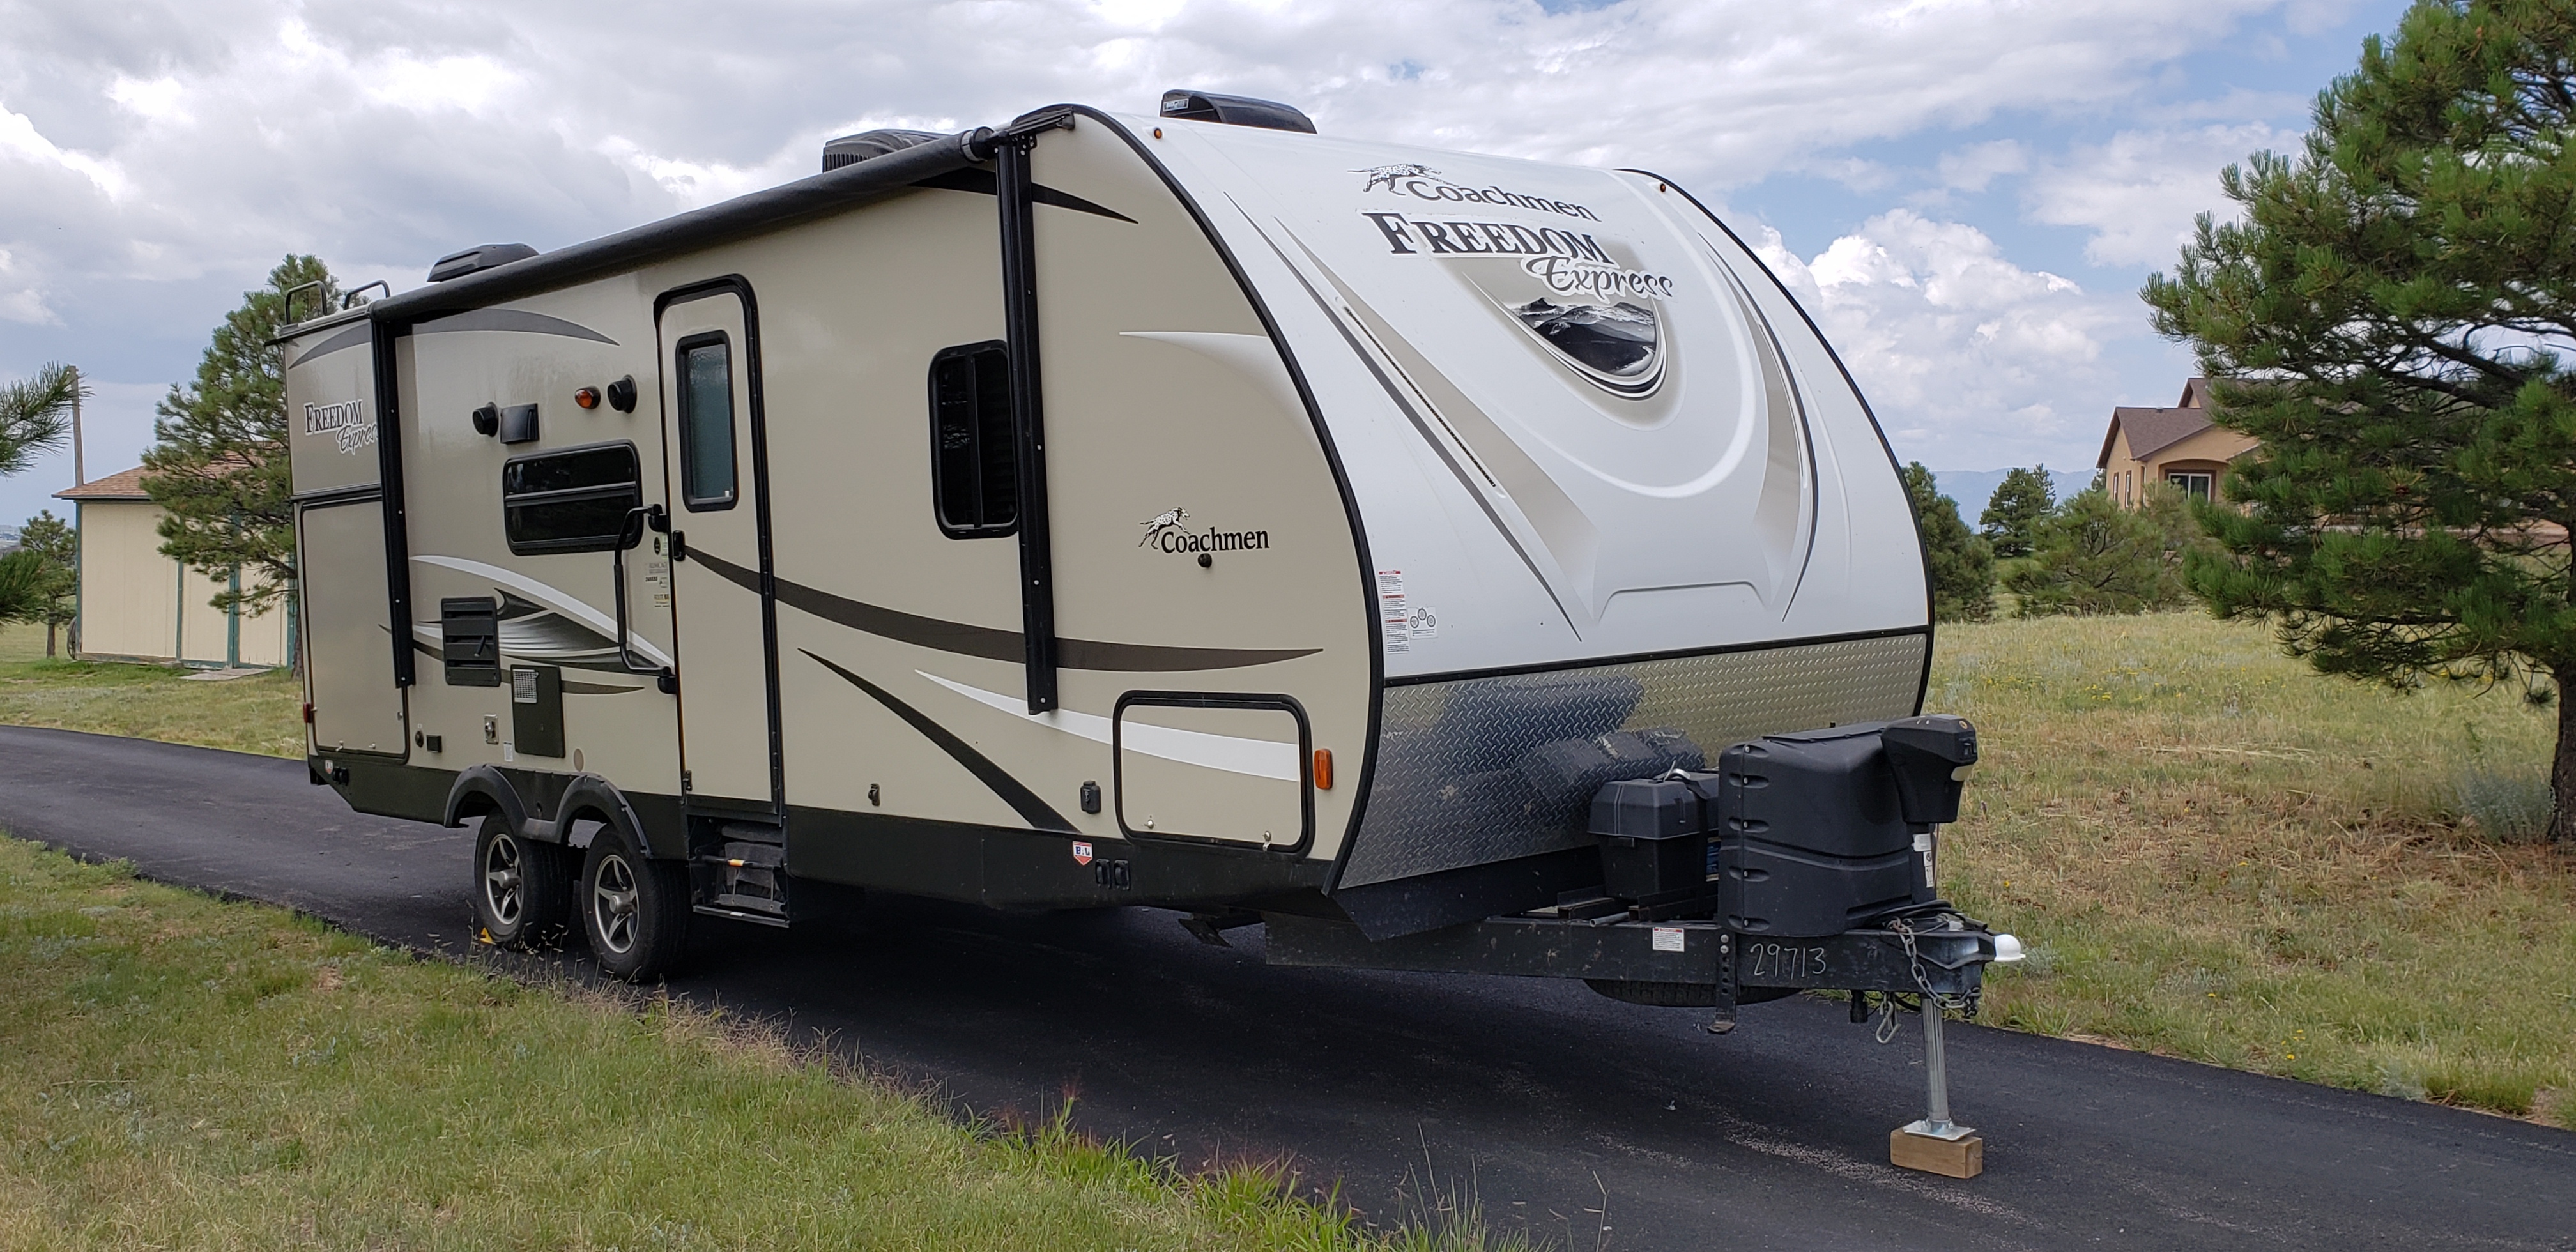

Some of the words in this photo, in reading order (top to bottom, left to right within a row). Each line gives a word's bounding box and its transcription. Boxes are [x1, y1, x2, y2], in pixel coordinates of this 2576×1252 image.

[1406, 180, 1603, 222] Coachmen
[1361, 211, 1614, 265] FREEDOM
[1526, 255, 1673, 300] Express
[304, 401, 363, 433] FREEDOM
[337, 424, 379, 453] Expres
[1161, 526, 1270, 554] Coachmen
[1749, 943, 1827, 981] 29713
